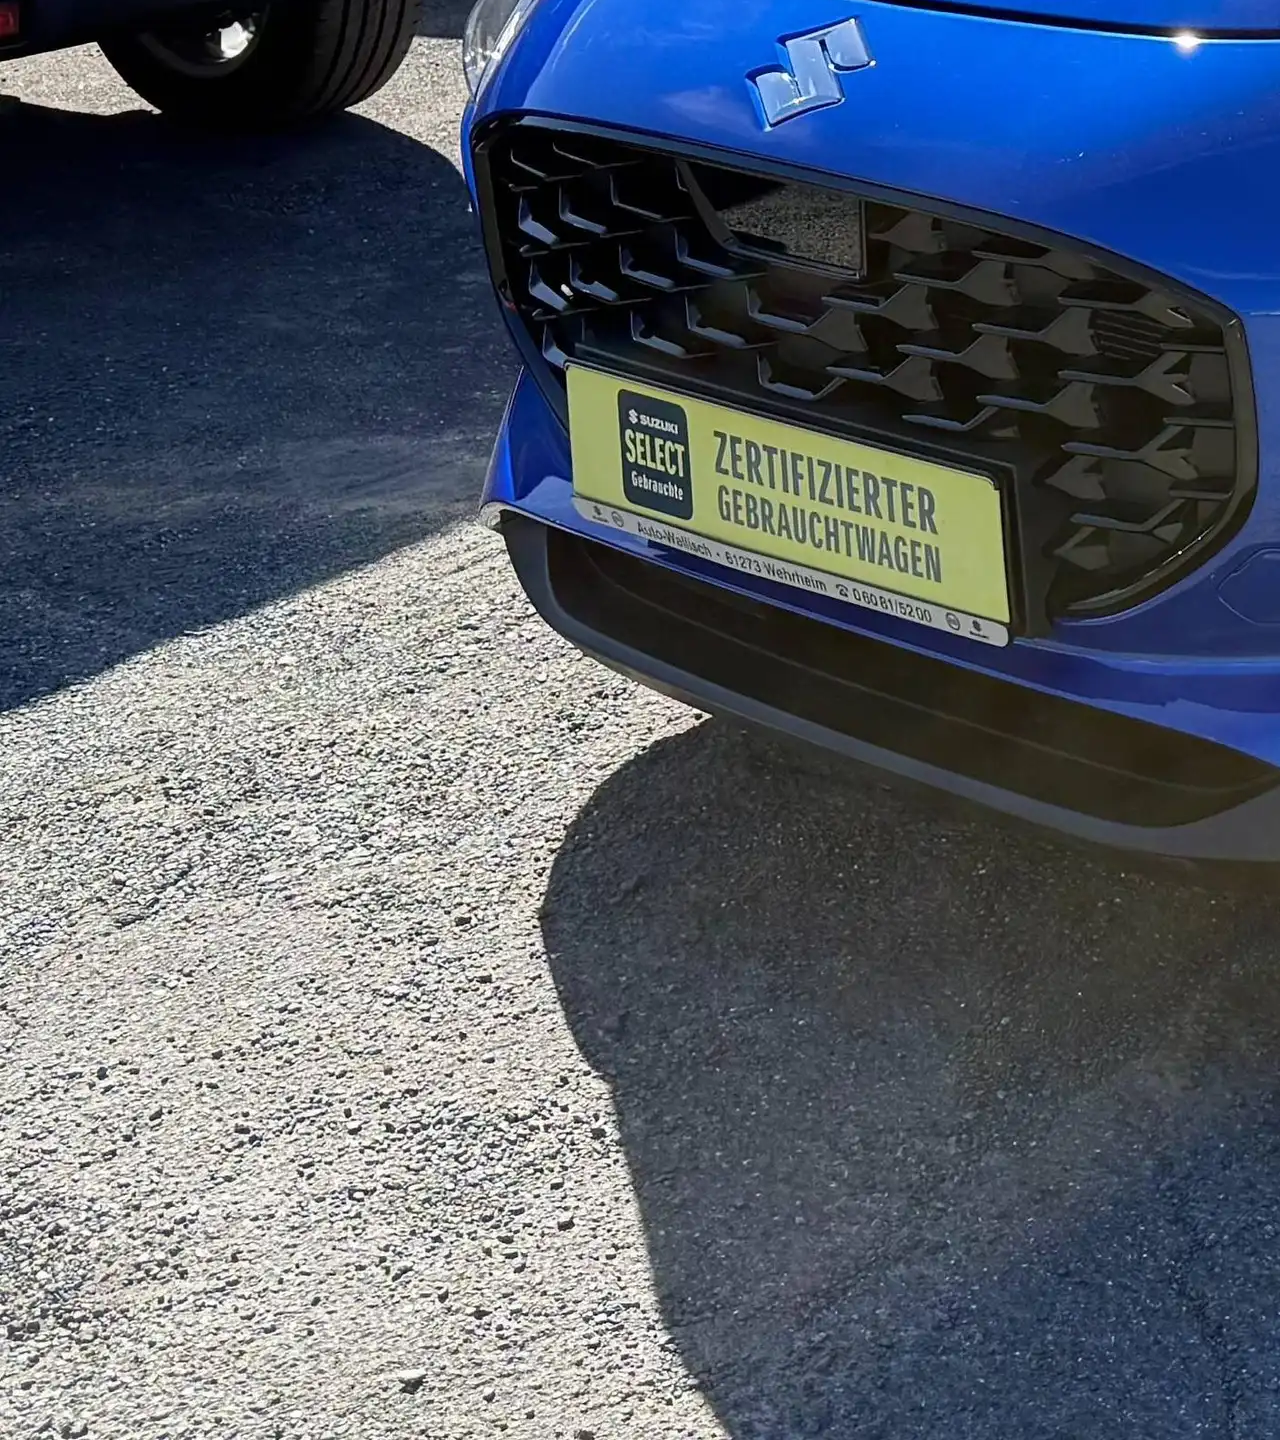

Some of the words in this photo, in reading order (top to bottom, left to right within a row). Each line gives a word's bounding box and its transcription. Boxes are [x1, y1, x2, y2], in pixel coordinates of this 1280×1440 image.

[639, 413, 679, 435] SUZUKI
[624, 428, 685, 478] SELECT
[631, 470, 684, 501] Gebrauchte
[713, 430, 939, 535] ZERTIFIZIERTER
[717, 484, 943, 584] GEBRAUCHTWAGEN
[725, 550, 761, 574] 61273
